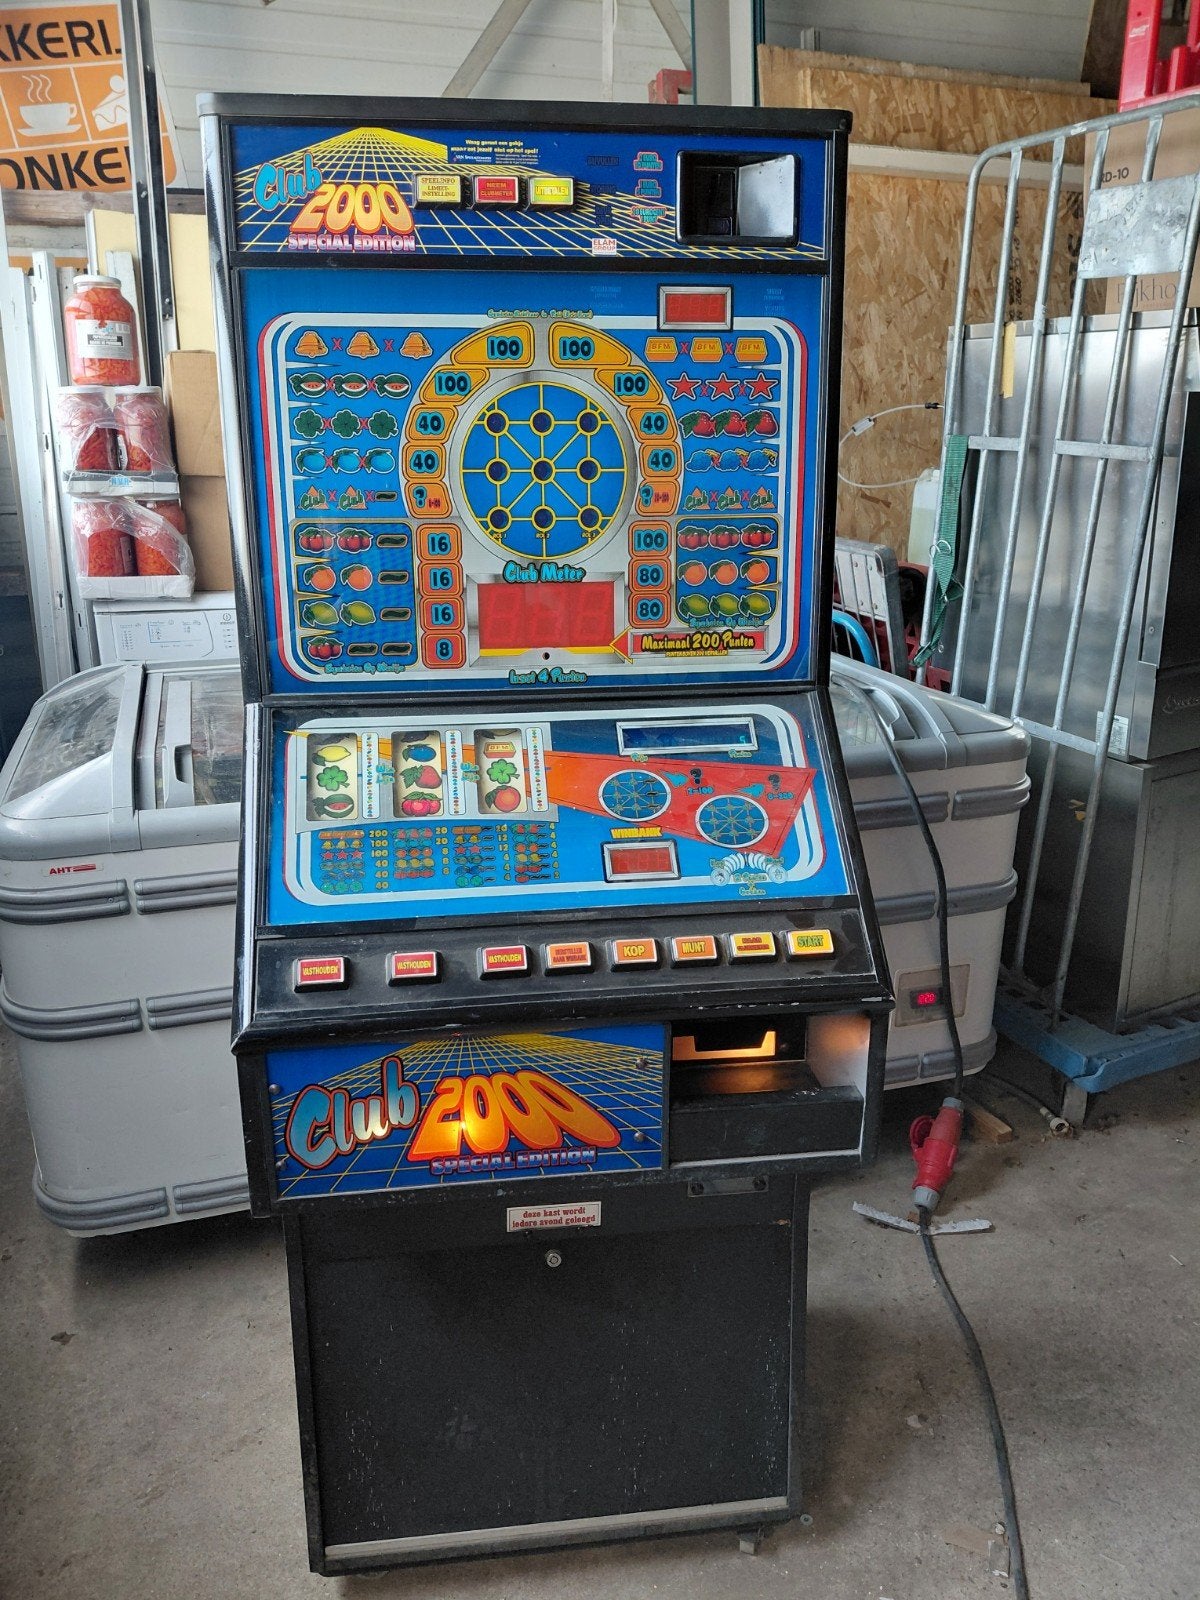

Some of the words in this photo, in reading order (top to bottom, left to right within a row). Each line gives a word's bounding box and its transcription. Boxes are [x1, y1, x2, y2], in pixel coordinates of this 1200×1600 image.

[0, 19, 122, 62] KERI
[254, 151, 323, 211] Club
[290, 182, 415, 235] 2000
[288, 234, 352, 250] SPECIAL
[354, 235, 416, 251] EDITION
[489, 338, 521, 358] 100
[561, 338, 593, 358] 100
[437, 374, 469, 393] 100
[615, 374, 647, 393] 100
[418, 414, 443, 432] 40
[642, 415, 665, 432] 40
[412, 453, 437, 470] 40
[651, 452, 674, 469] 40
[430, 535, 449, 554] 16
[636, 532, 666, 549] 100
[432, 570, 450, 588] 16
[504, 560, 538, 582] Club
[541, 562, 585, 582] Meter
[639, 567, 660, 584] 80
[433, 605, 452, 623] 16
[639, 601, 660, 618] 80
[438, 640, 450, 658] 8
[642, 635, 690, 650] Maximaal
[692, 633, 719, 649] 200
[722, 631, 754, 648] Punten
[537, 668, 549, 683] 4
[369, 829, 388, 838] 200
[610, 826, 663, 839] WINBANK
[371, 839, 389, 848] 100
[371, 849, 388, 858] 100
[49, 866, 72, 875] AHT
[682, 941, 706, 954] MUNT
[797, 935, 824, 947] START
[487, 953, 522, 964] VASTHOUDEN
[623, 945, 645, 957] KOP
[302, 965, 339, 976] VASTHOUDEN
[396, 959, 432, 970] VASTHOUDEN
[286, 1056, 420, 1170] Club
[407, 1070, 621, 1162] 2000
[431, 1152, 515, 1175] SPECIAL
[516, 1146, 597, 1169] EDITION
[512, 1219, 538, 1228] iedere
[539, 1217, 563, 1226] avond
[565, 1214, 596, 1225] geleegd
[522, 1210, 541, 1219] deze
[543, 1209, 561, 1217] kast
[562, 1206, 586, 1215] wordt
